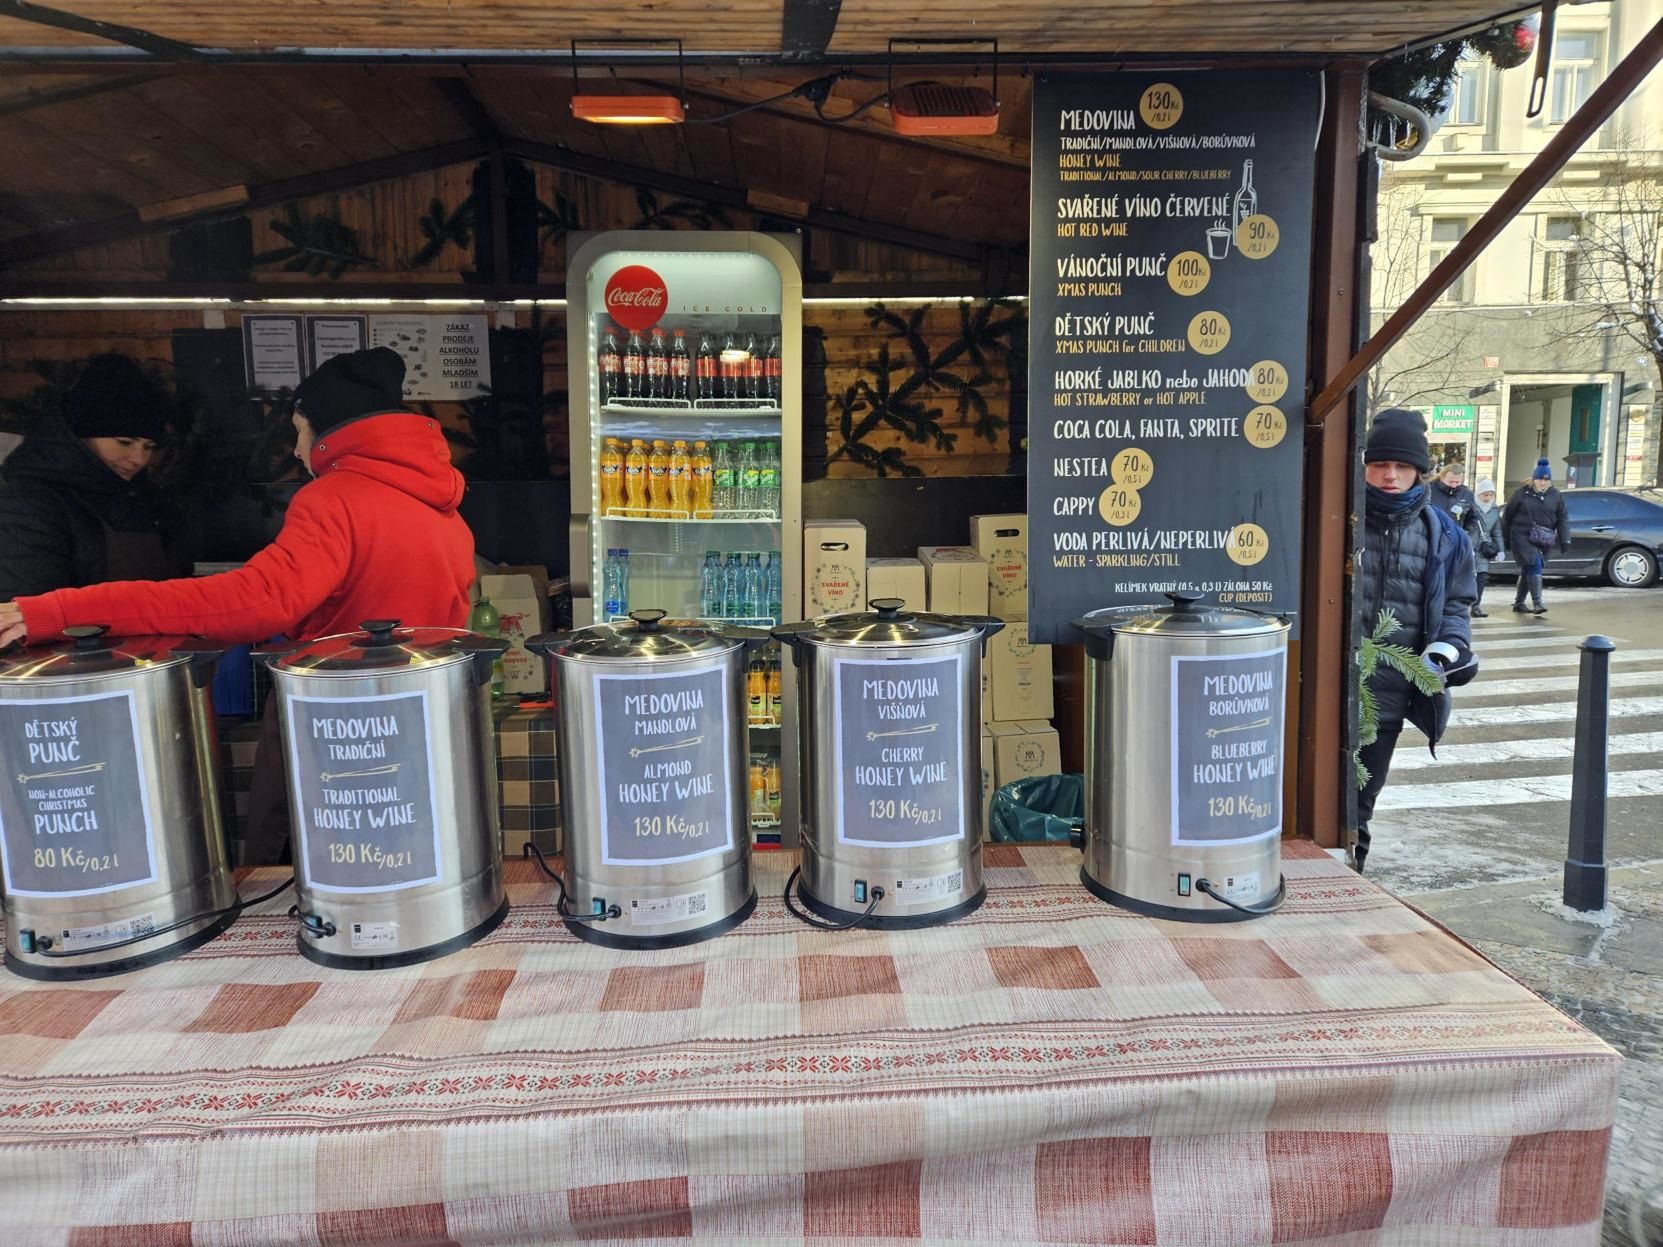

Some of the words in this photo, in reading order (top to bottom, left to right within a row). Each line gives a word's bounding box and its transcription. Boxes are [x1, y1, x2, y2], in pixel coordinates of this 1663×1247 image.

[1148, 92, 1170, 110] 130
[1060, 110, 1135, 130] MEDOVINA
[1060, 154, 1091, 168] HONEY
[1095, 154, 1121, 168] WINE
[1058, 194, 1120, 218] SVAŘENÉ
[1125, 194, 1160, 218] VÍNO
[1166, 193, 1231, 217] ČERVENÉ
[1058, 223, 1077, 237] HOT
[1080, 223, 1098, 237] RED
[1102, 222, 1128, 237] WINE
[1249, 222, 1265, 240] 90
[1058, 254, 1122, 278] VÁNOČNÍ
[1127, 252, 1166, 277] PUNČ
[1176, 258, 1199, 276] 100
[608, 287, 664, 307] Coca-Cola
[1058, 283, 1085, 297] XMAS
[1088, 282, 1122, 296] PUNCH
[446, 323, 470, 331] ZÁKAZ
[1056, 312, 1110, 336] DĚTSKÝ
[1115, 312, 1155, 336] PUNČ
[1200, 318, 1217, 336] 80
[1056, 341, 1084, 354] XMAS
[1087, 340, 1120, 354] PUNCH
[1122, 340, 1136, 353] for
[1138, 339, 1186, 353] CHILDREN
[1056, 366, 1102, 390] HORKÉ
[1108, 369, 1162, 389] JABLKO
[1166, 369, 1198, 388] nebo
[1203, 368, 1256, 388] JAHODA
[1257, 368, 1274, 385] 80
[1054, 393, 1072, 406] HOT
[1076, 392, 1141, 406] STRAWBERRY
[1144, 396, 1154, 406] or
[1157, 392, 1175, 405] HOT
[1178, 392, 1206, 404] APPLE
[1256, 412, 1272, 430] 70
[1442, 408, 1464, 417] MINI
[1054, 420, 1090, 440] COCA
[1095, 419, 1136, 440] COLA,
[1140, 418, 1184, 440] FANTA,
[1188, 418, 1240, 438] SPRITE
[1434, 420, 1471, 429] MARKET
[1054, 458, 1108, 478] NESTEA
[1122, 455, 1139, 472] 70
[1054, 497, 1096, 516] CAPPY
[1110, 491, 1126, 508] 70
[1054, 532, 1088, 551] VODA
[1093, 526, 1237, 550] PERLIVÁ/NEPERLIVÁ
[1238, 530, 1254, 548] 60
[1054, 555, 1086, 568] WATER
[1096, 554, 1181, 568] SPARKLING/STILL
[1115, 581, 1148, 593] KELÍMEK
[1149, 580, 1176, 593] VRATNÝ
[1224, 580, 1250, 592] ZÁLOHA
[1252, 581, 1262, 592] 50
[1262, 581, 1272, 591] Kč
[1219, 593, 1234, 602] CUP
[1236, 592, 1272, 603] (DEPOSIT)
[863, 678, 939, 700] MEDOVINA
[1203, 670, 1272, 696] MEDOVINA
[624, 690, 704, 716] MEDOVINA
[878, 700, 926, 720] VIŠŇOVÁ
[1208, 695, 1270, 716] BORŮVKOVÁ
[25, 717, 78, 738] DĚTSKÝ
[312, 716, 398, 740] MEDOVINA
[634, 714, 696, 736] MANDLOVÁ
[29, 736, 80, 764] PUNČ
[328, 740, 386, 760] TRADIČNÍ
[882, 747, 924, 763] CHERRY
[1211, 740, 1268, 760] BLUEBERRY
[644, 760, 692, 780] ALMOND
[856, 766, 903, 786] HONEY
[909, 762, 948, 785] WINE
[1193, 762, 1244, 784] HONEY
[1247, 755, 1276, 780] WINE
[28, 786, 95, 800] NON-ALCOHOLIC
[322, 786, 400, 805] TRADITIONAL
[619, 782, 668, 804] HONEY
[674, 774, 714, 800] WINE
[38, 798, 88, 812] CHRISTMAS
[869, 800, 896, 819] 130
[1208, 798, 1234, 817] 130
[34, 810, 98, 834] PUNCH
[314, 808, 361, 830] HONEY
[368, 803, 416, 828] WINE
[634, 816, 661, 836] 130
[34, 848, 55, 868] 80
[328, 844, 354, 864] 130
